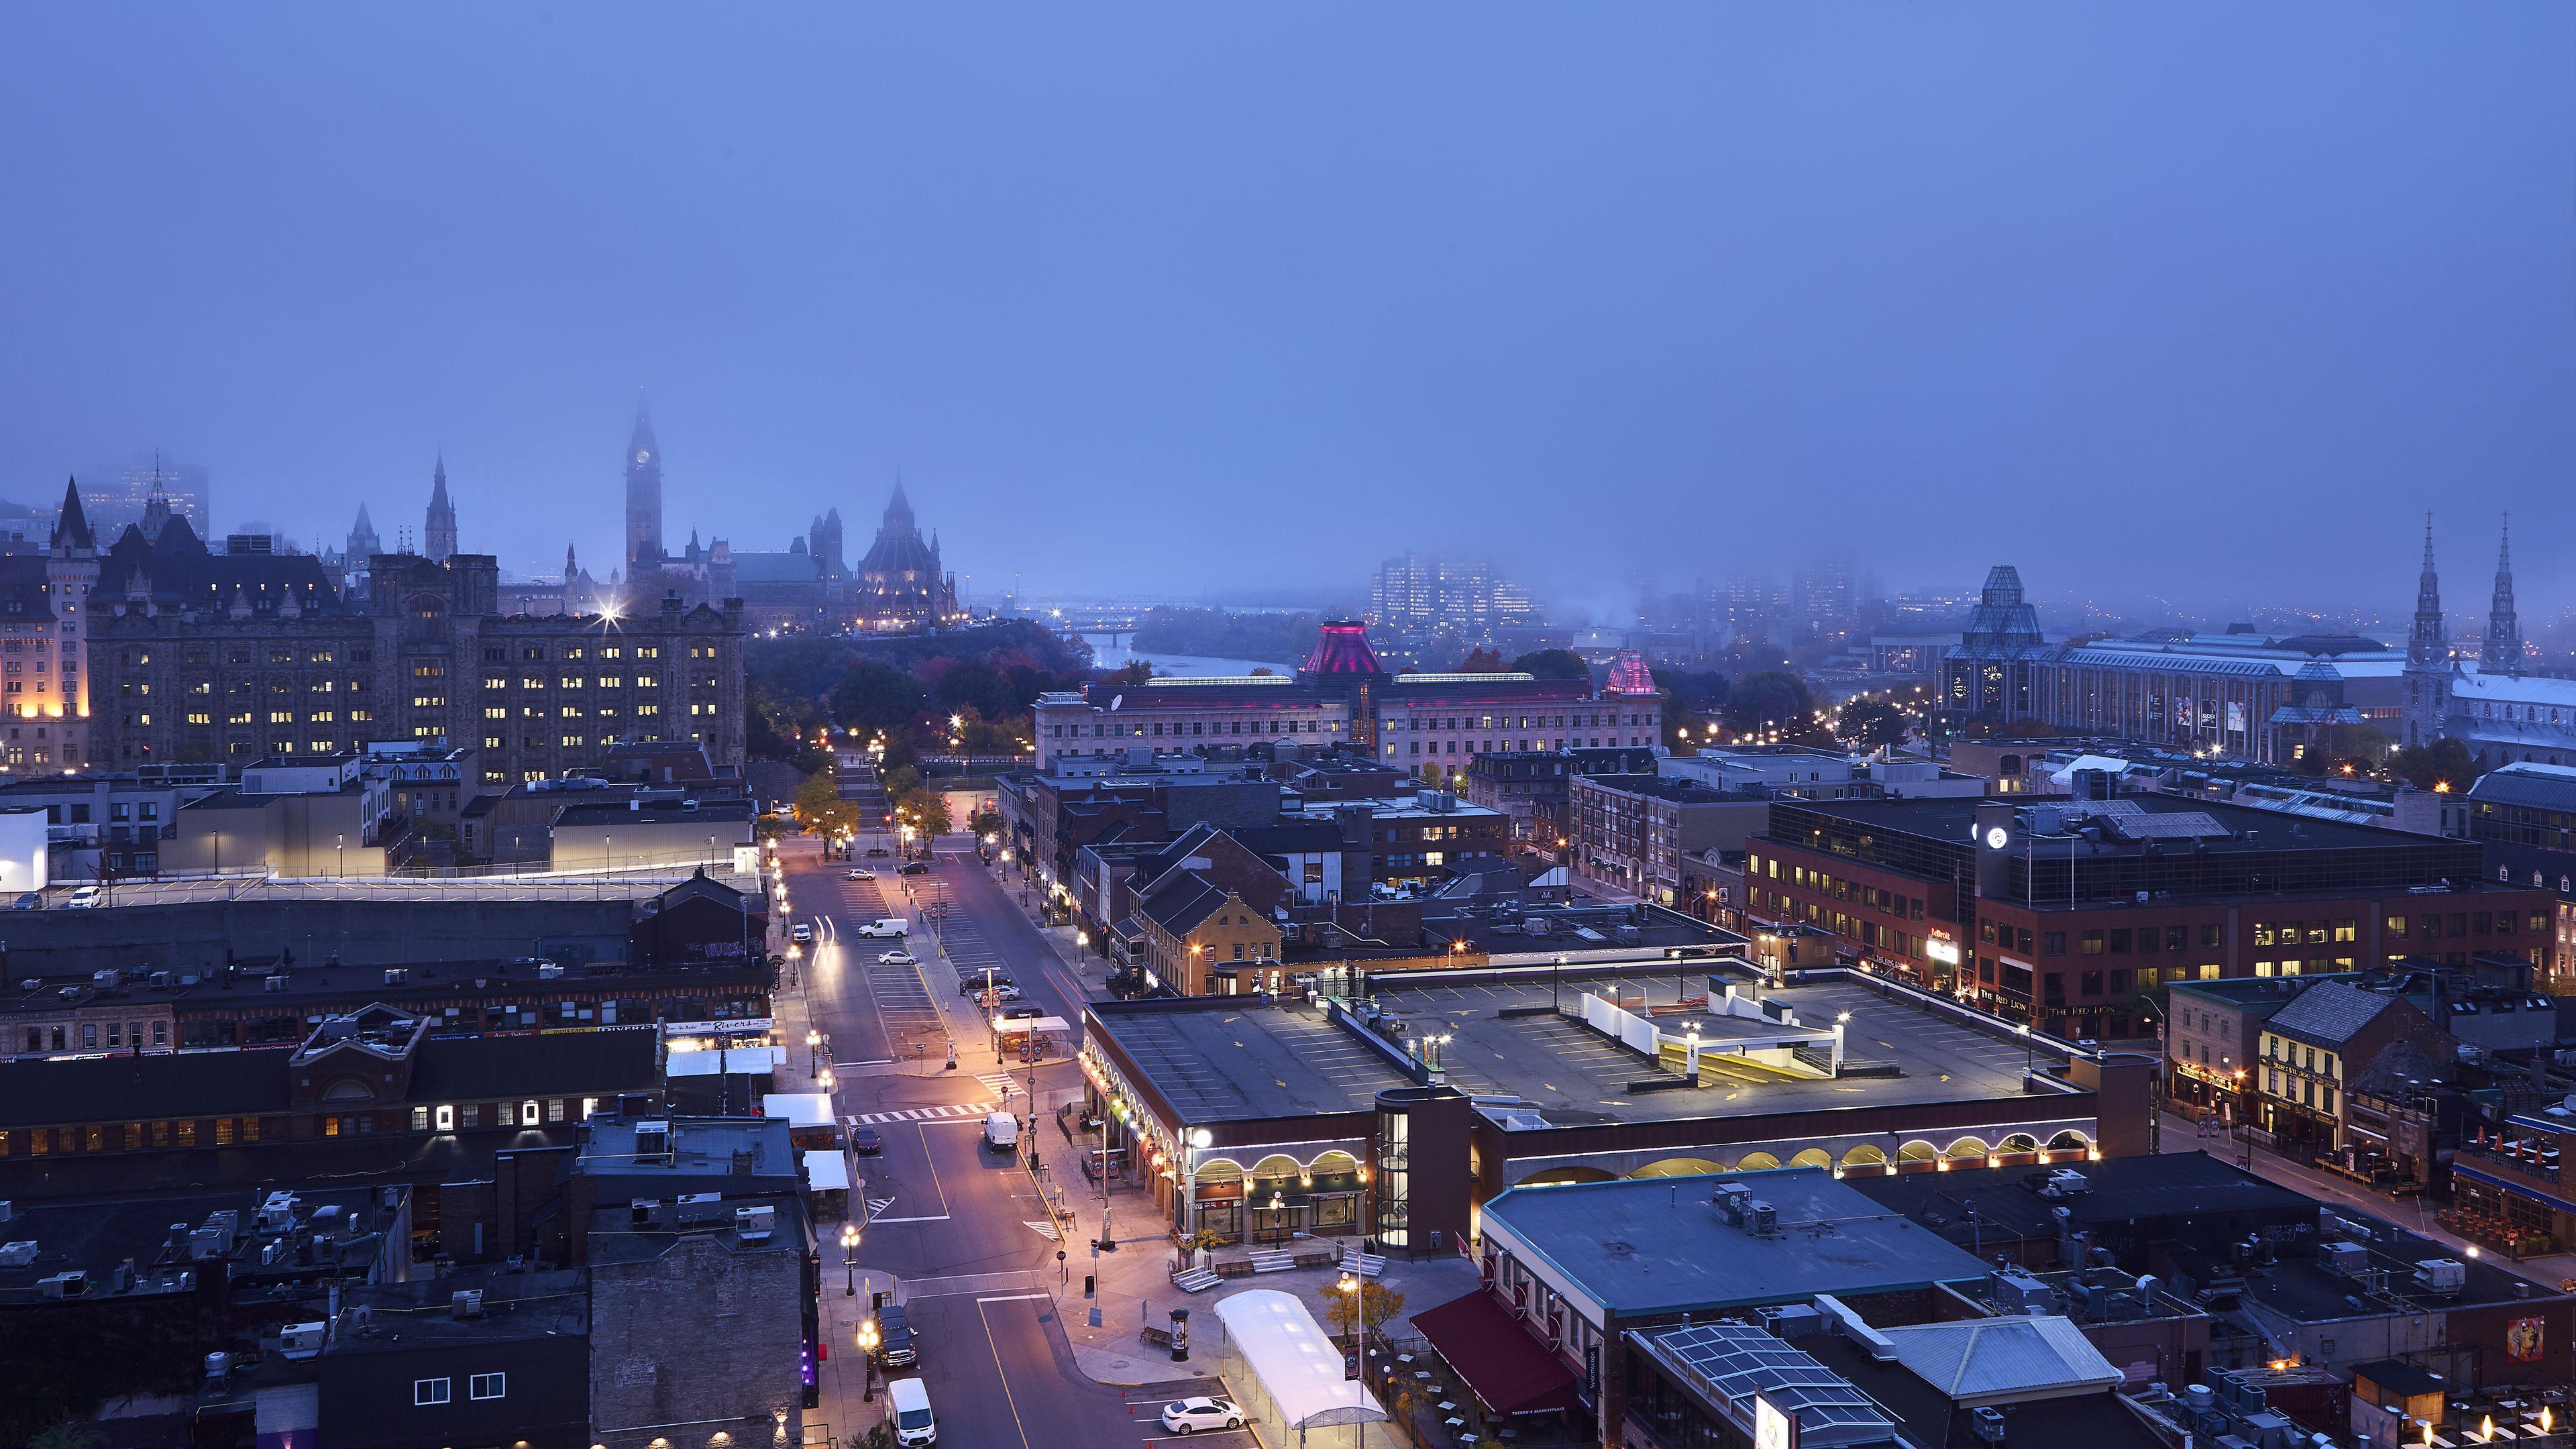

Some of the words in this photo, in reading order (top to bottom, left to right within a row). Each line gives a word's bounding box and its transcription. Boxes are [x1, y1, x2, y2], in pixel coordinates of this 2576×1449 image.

[1931, 927, 1951, 941] LeDroit
[1981, 989, 1993, 1000] THE
[1996, 994, 2008, 1005] RED
[2010, 999, 2027, 1011] LION
[2049, 1008, 2067, 1016] THE
[2072, 1007, 2089, 1015] RED
[713, 1020, 751, 1030] Rivers
[2289, 1067, 2311, 1079] VILAGE
